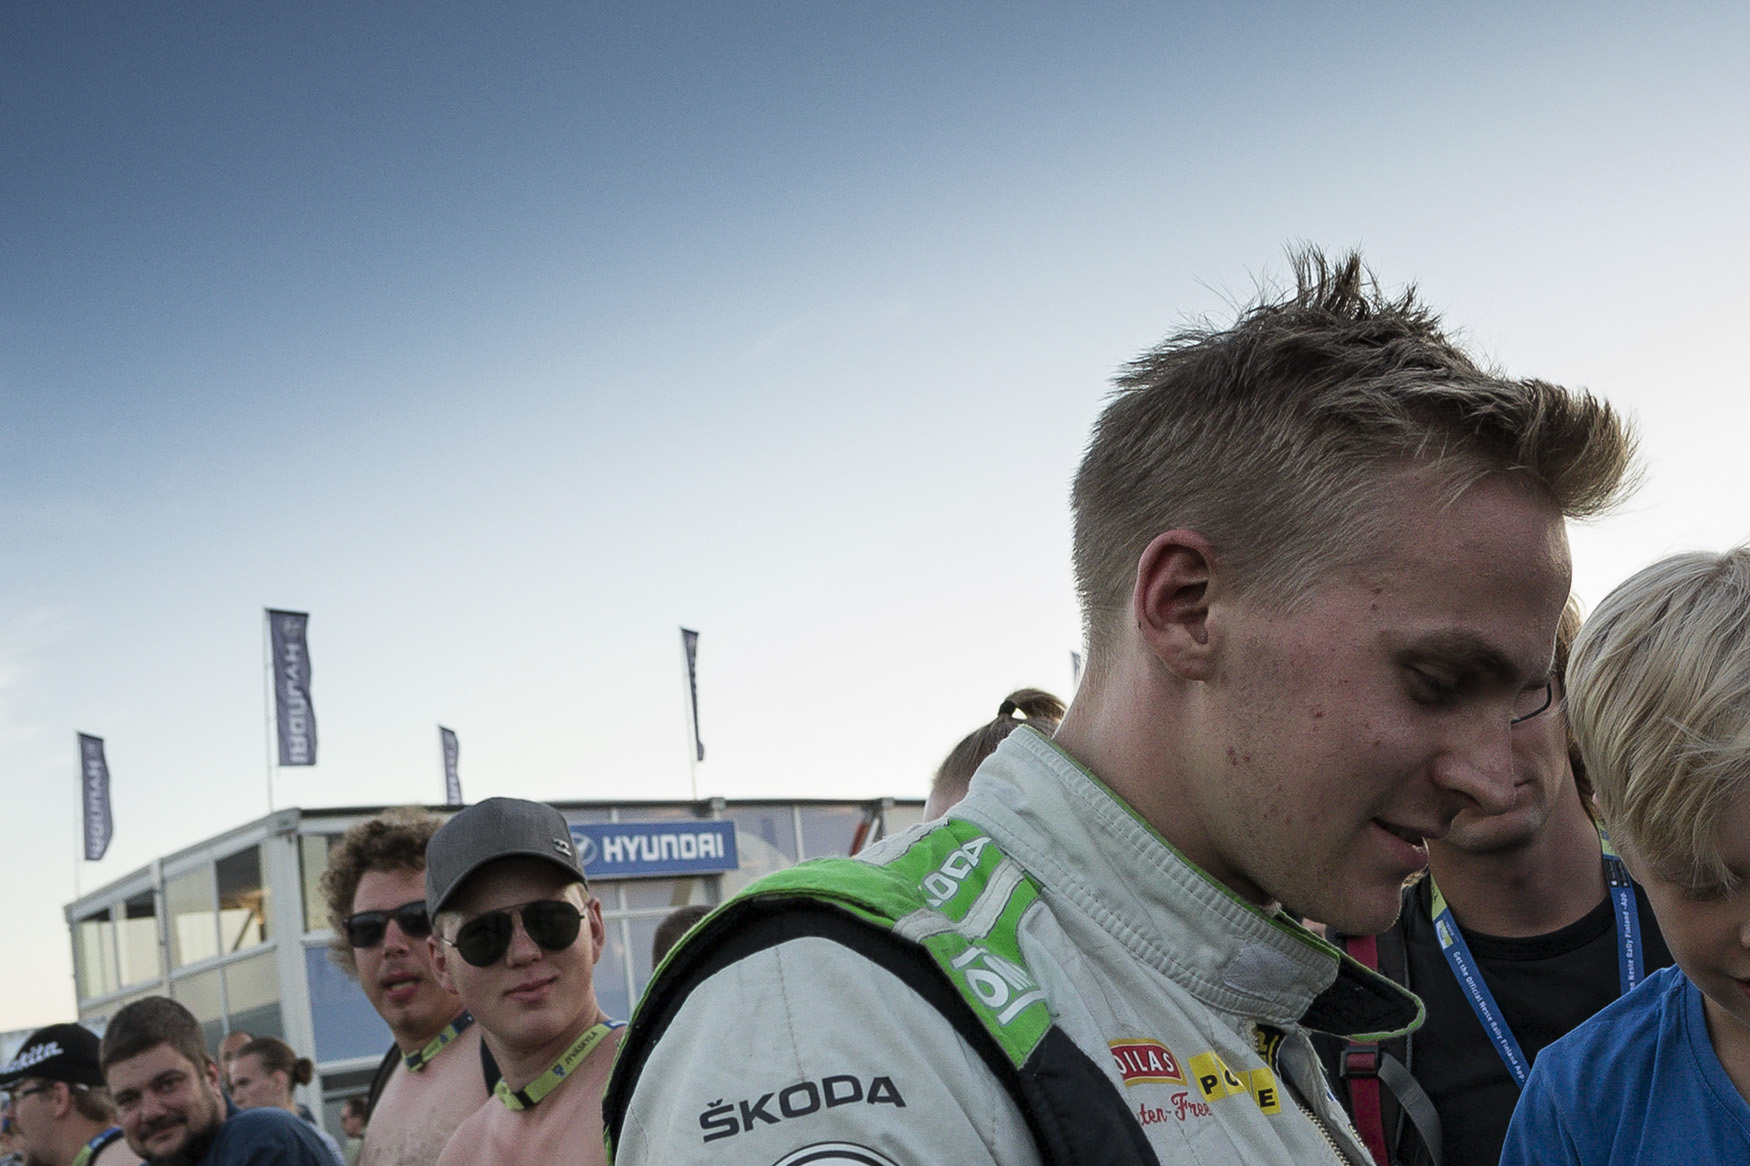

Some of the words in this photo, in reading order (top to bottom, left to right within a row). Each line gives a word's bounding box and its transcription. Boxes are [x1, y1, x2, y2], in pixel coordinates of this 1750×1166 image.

[603, 832, 725, 863] HYUNDAI
[922, 836, 992, 908] ODA
[1453, 951, 1463, 965] Get
[1459, 964, 1469, 976] the
[1466, 976, 1483, 1002] Official
[1479, 1001, 1493, 1021] Neste
[1490, 1021, 1503, 1040] Rally
[1500, 1039, 1518, 1065] Finland
[699, 1074, 907, 1143] ŠKODA
